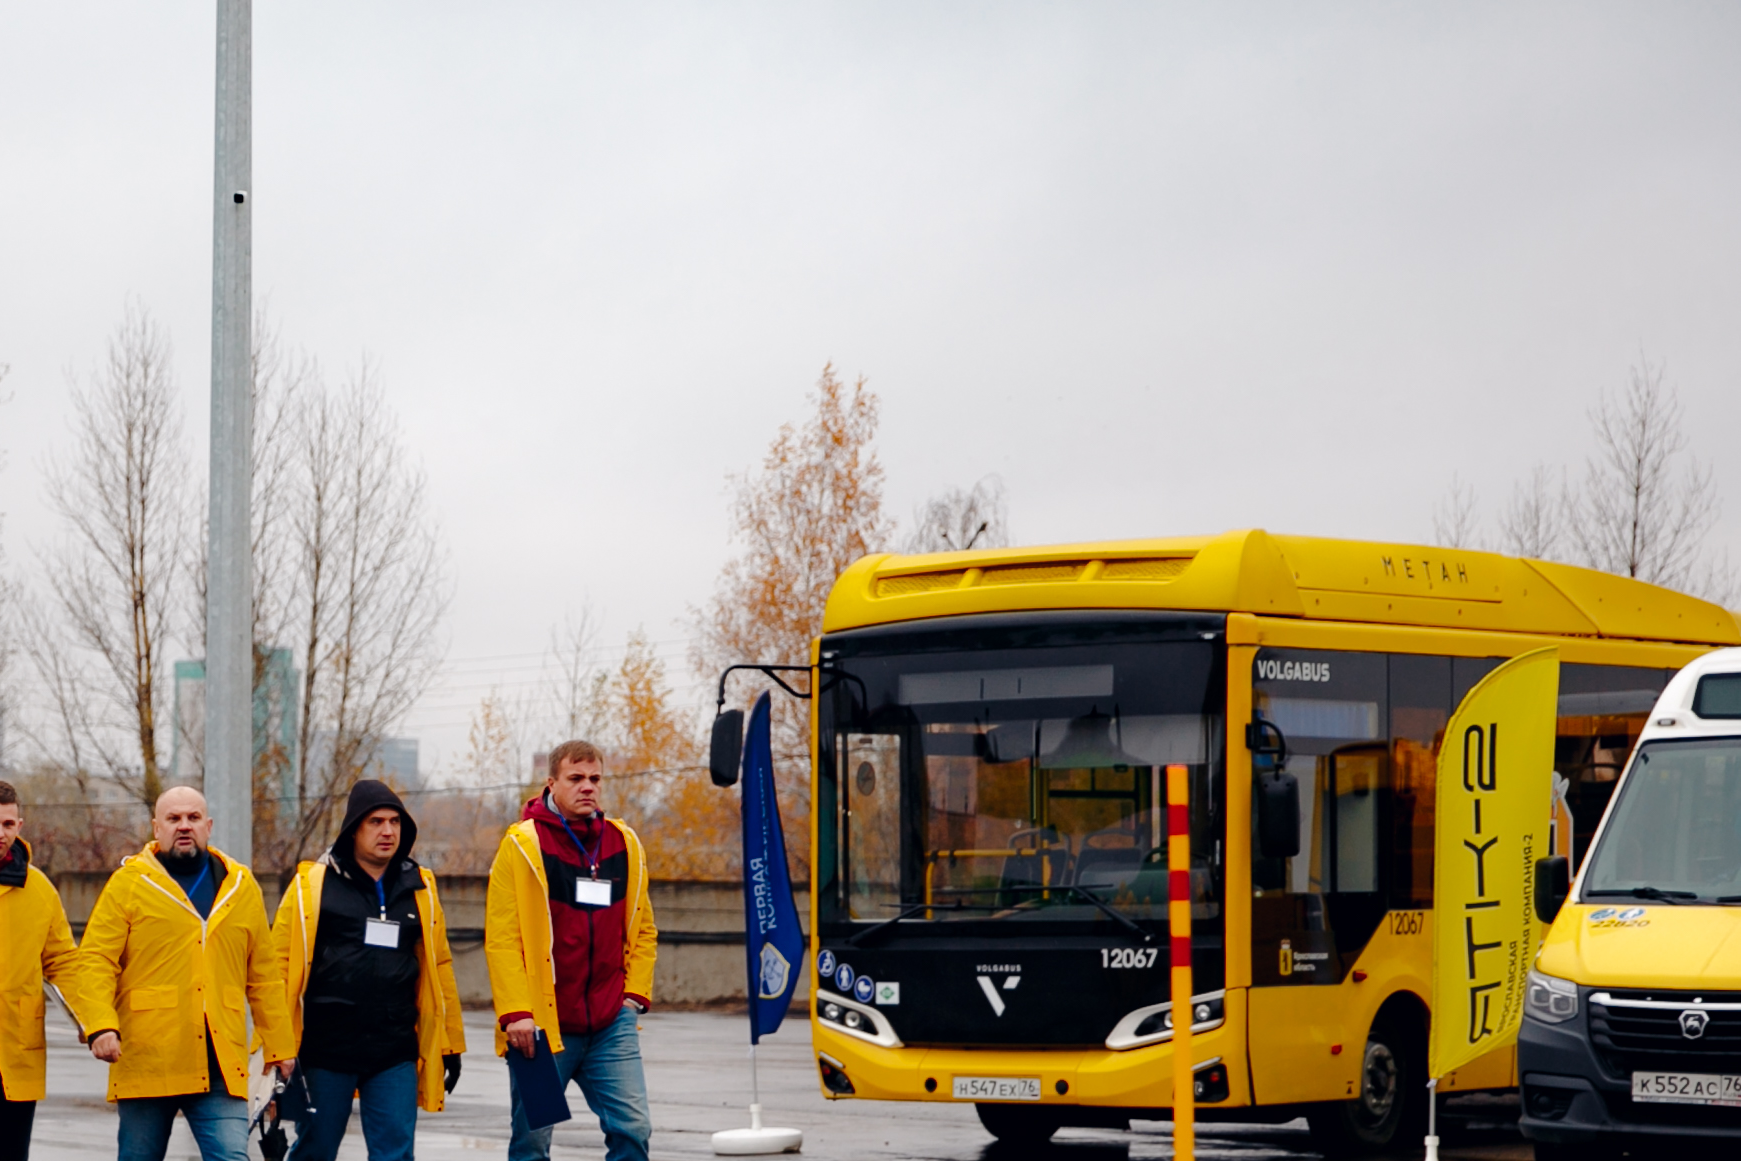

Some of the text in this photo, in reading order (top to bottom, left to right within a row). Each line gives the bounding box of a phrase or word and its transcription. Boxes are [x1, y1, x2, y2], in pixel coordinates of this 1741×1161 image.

[1380, 556, 1469, 584] МЕТАН
[1257, 660, 1331, 682] VOLGABUS
[1522, 833, 1533, 925] КОМПАНИЯ-2
[1388, 912, 1424, 935] 12067
[1591, 919, 1651, 928] 22820
[976, 964, 1022, 972] VOLGABUS
[1100, 948, 1158, 968] 12067
[1020, 1081, 1036, 1093] 76
